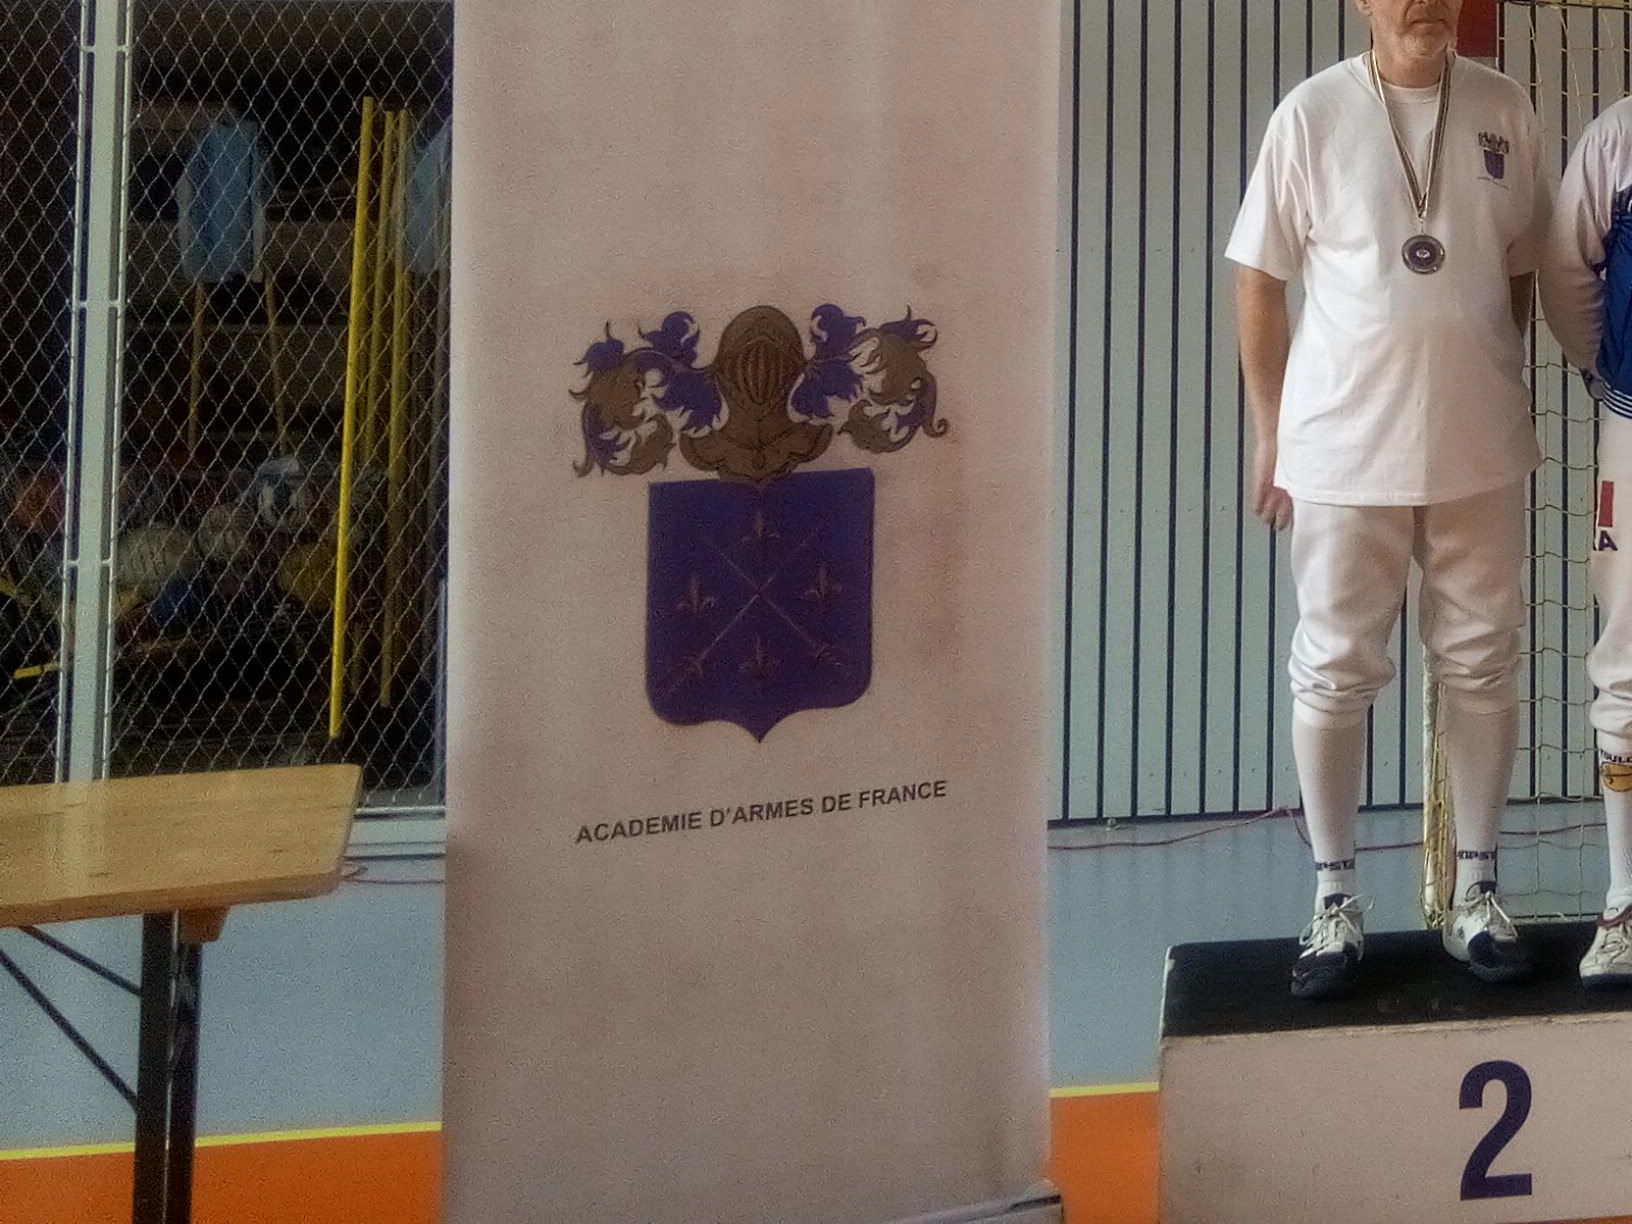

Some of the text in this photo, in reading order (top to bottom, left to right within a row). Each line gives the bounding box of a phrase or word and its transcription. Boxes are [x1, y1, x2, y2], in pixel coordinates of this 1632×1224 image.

[575, 780, 948, 844] ACADEMIE D'ARMES DE FRANCE
[1458, 1059, 1534, 1201] 2
